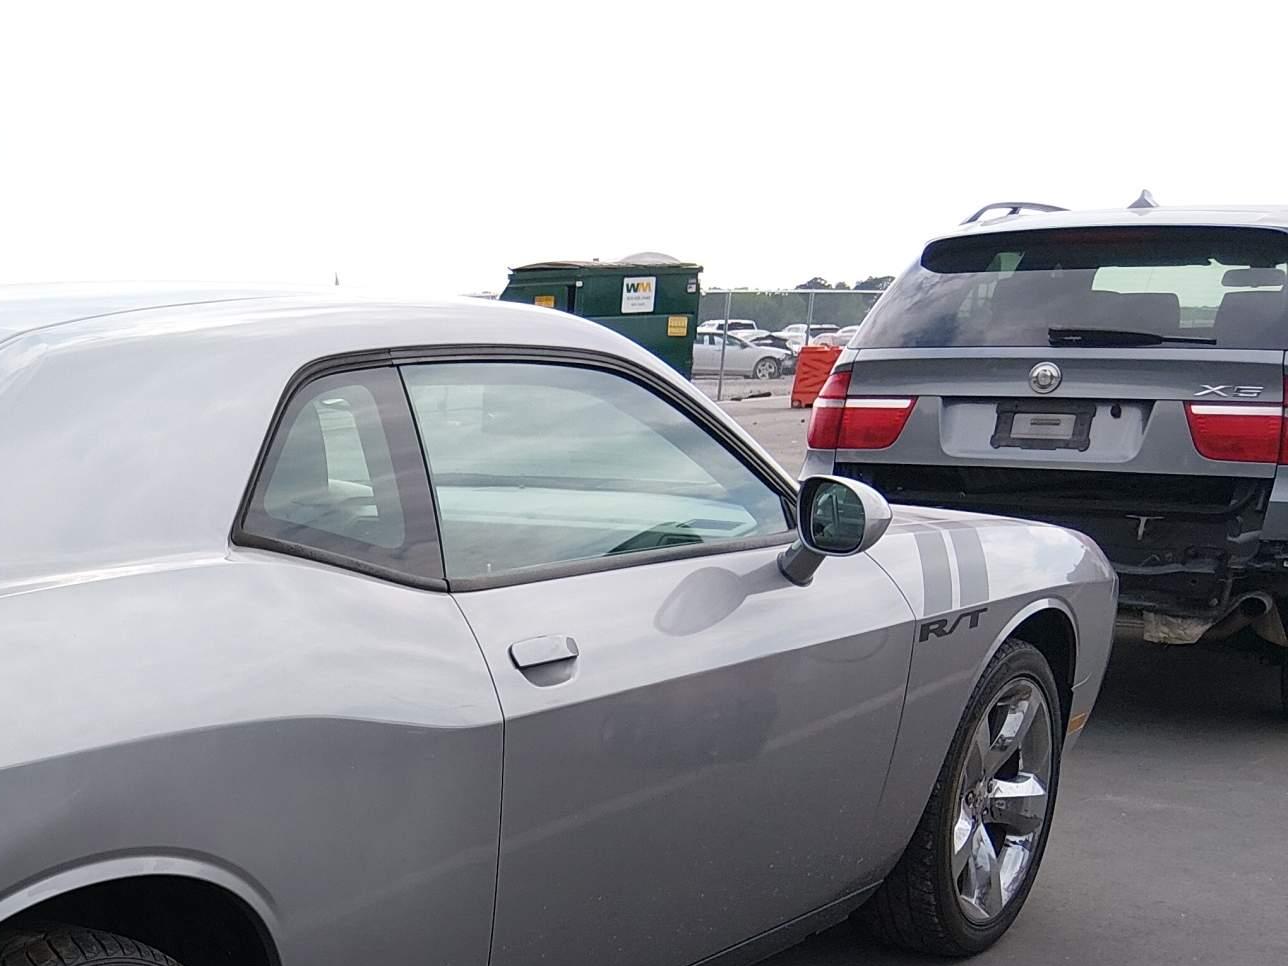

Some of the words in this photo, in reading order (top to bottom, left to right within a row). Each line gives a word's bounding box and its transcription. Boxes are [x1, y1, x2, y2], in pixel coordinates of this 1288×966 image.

[626, 282, 651, 294] WM
[1193, 385, 1264, 398] X5
[919, 608, 988, 642] R/T
